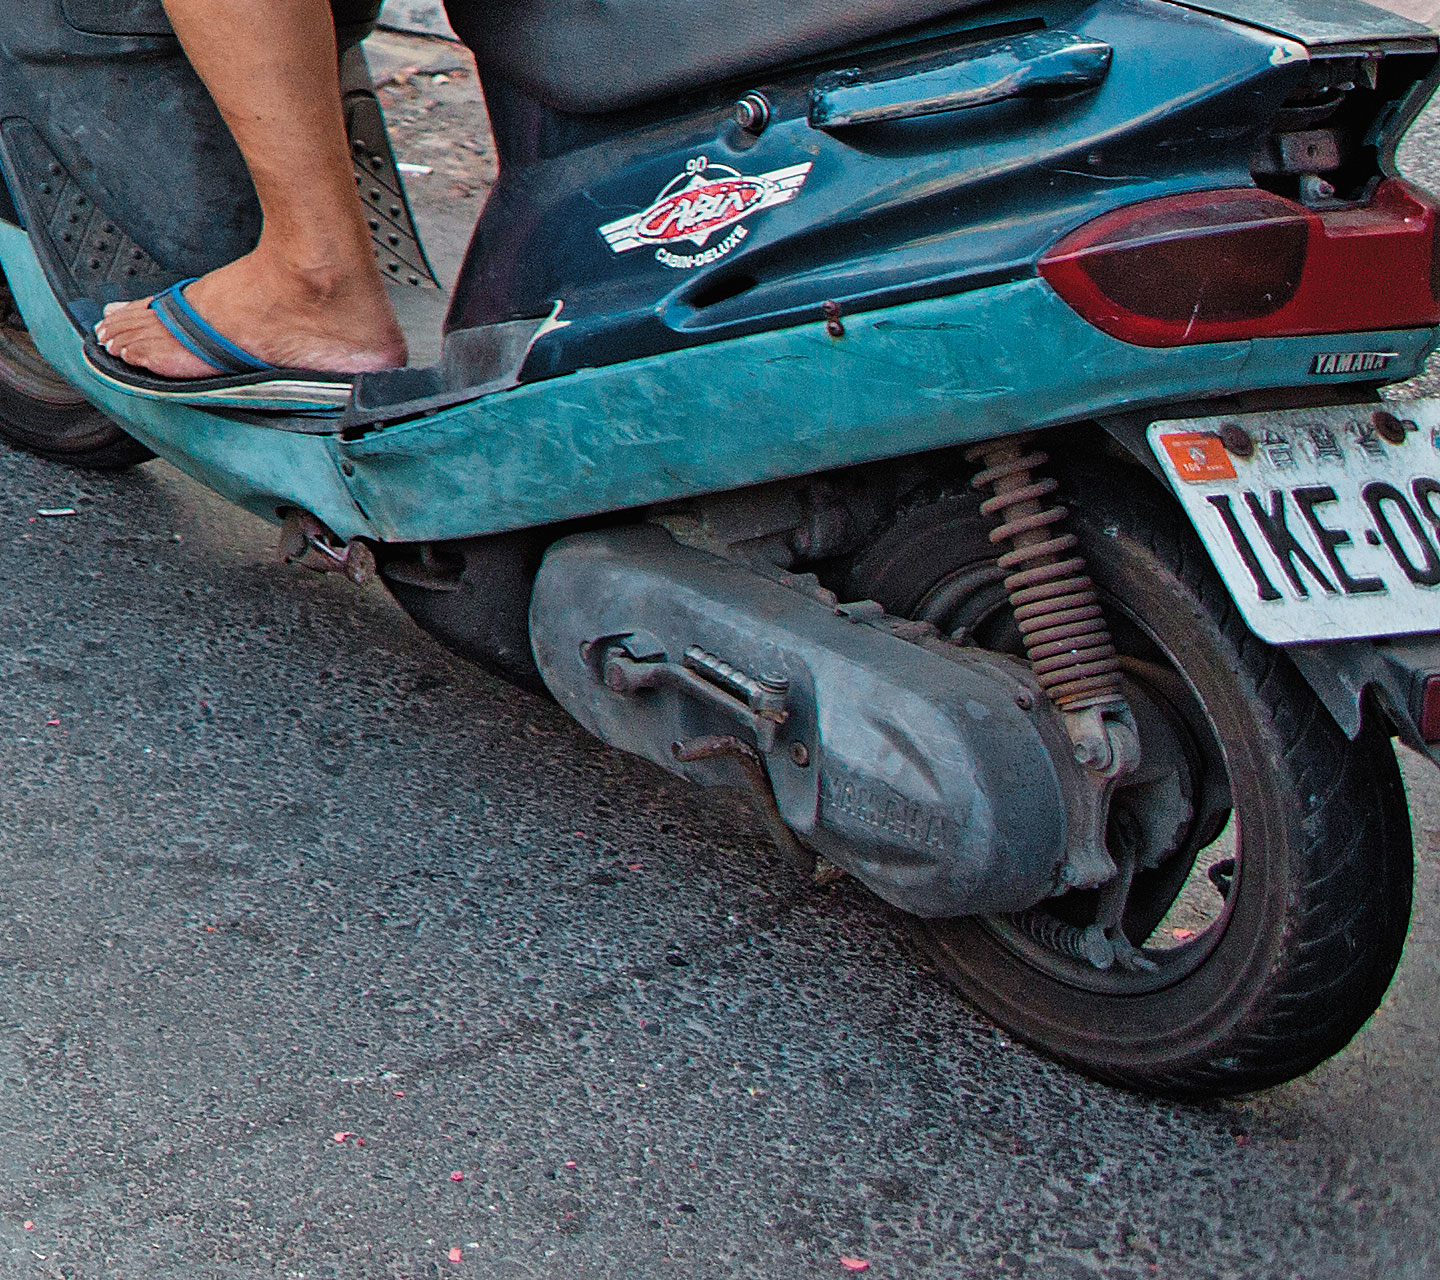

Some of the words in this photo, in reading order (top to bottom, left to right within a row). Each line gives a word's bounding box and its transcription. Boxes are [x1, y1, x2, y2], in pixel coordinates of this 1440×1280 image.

[685, 155, 708, 175] 90
[654, 224, 749, 269] CABIN-DELUXE
[1314, 353, 1387, 374] YAMAHA
